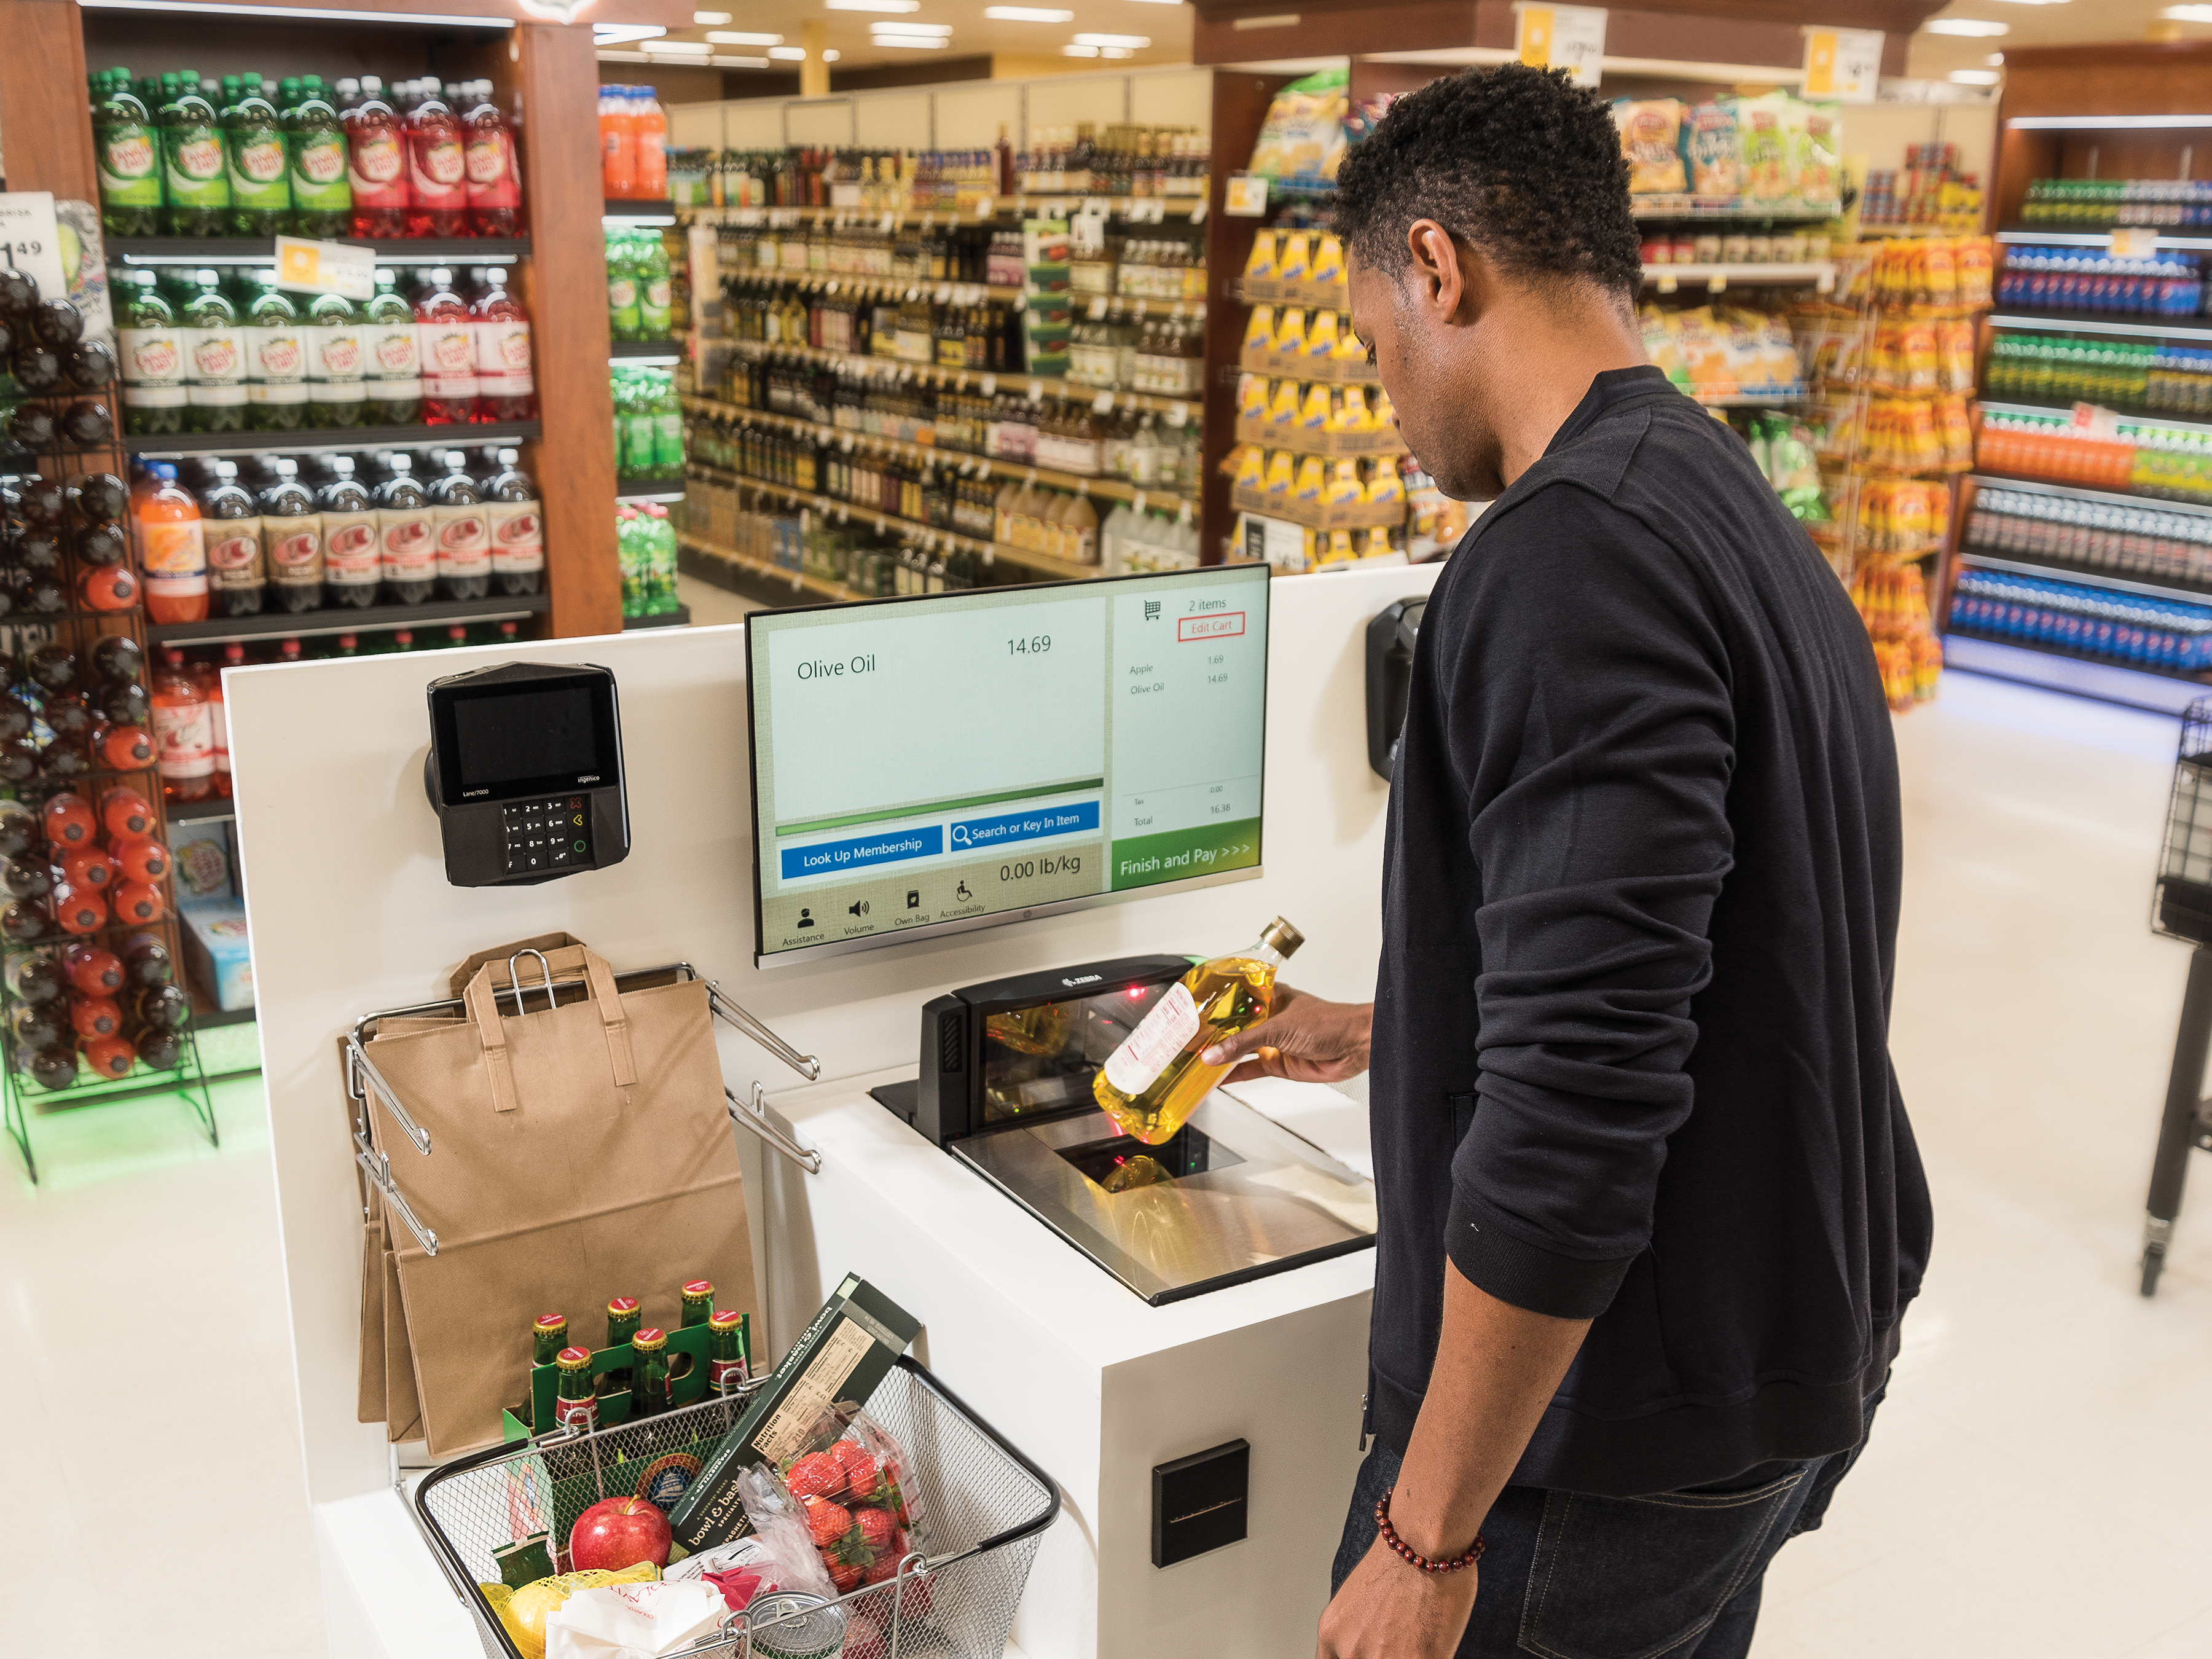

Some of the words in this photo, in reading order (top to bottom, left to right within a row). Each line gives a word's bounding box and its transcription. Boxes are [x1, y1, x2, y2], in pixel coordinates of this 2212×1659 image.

[1189, 600, 1195, 611] 2
[1199, 598, 1227, 610] items
[1191, 621, 1209, 633] Edit
[1212, 620, 1232, 631] Cart
[1007, 635, 1052, 656] 14.69
[797, 657, 844, 680] Olive
[850, 654, 876, 674] Oil
[1129, 663, 1154, 675] Apple
[1208, 654, 1224, 664] 1.69
[1131, 684, 1151, 694] Olive
[1153, 681, 1164, 691] Oil
[1207, 673, 1228, 683] 14.69
[578, 775, 600, 783] ingenico
[1134, 815, 1153, 826] Total
[1210, 803, 1231, 814] 16.38
[972, 825, 1006, 840] Search
[1009, 824, 1021, 833] or
[1023, 820, 1042, 832] Key
[1044, 817, 1054, 828] In
[1056, 814, 1079, 826] Item
[804, 852, 831, 867] Look
[834, 850, 850, 863] Up
[853, 837, 922, 859] Membership
[1120, 855, 1161, 876] Finish
[1164, 850, 1190, 868] and
[1194, 848, 1217, 864] Pay
[1000, 861, 1034, 881] 0.00
[1040, 855, 1081, 875] lb/kg
[895, 917, 913, 926] Own
[915, 914, 930, 923] Bag
[939, 904, 986, 919] Accessibility
[782, 933, 825, 947] Assistance
[844, 924, 874, 935] Volume
[1074, 974, 1103, 984] ZEBRA
[810, 1304, 833, 1332] bowl
[802, 1331, 813, 1343] &
[775, 1342, 805, 1380] basket
[753, 1412, 782, 1448] Nutrition
[758, 1429, 778, 1453] Facts
[791, 1427, 806, 1443] 210
[716, 1496, 742, 1528] SPECIALTY
[688, 1514, 715, 1547] bowl
[709, 1503, 724, 1519] &
[599, 1580, 680, 1603] COLAVIT
